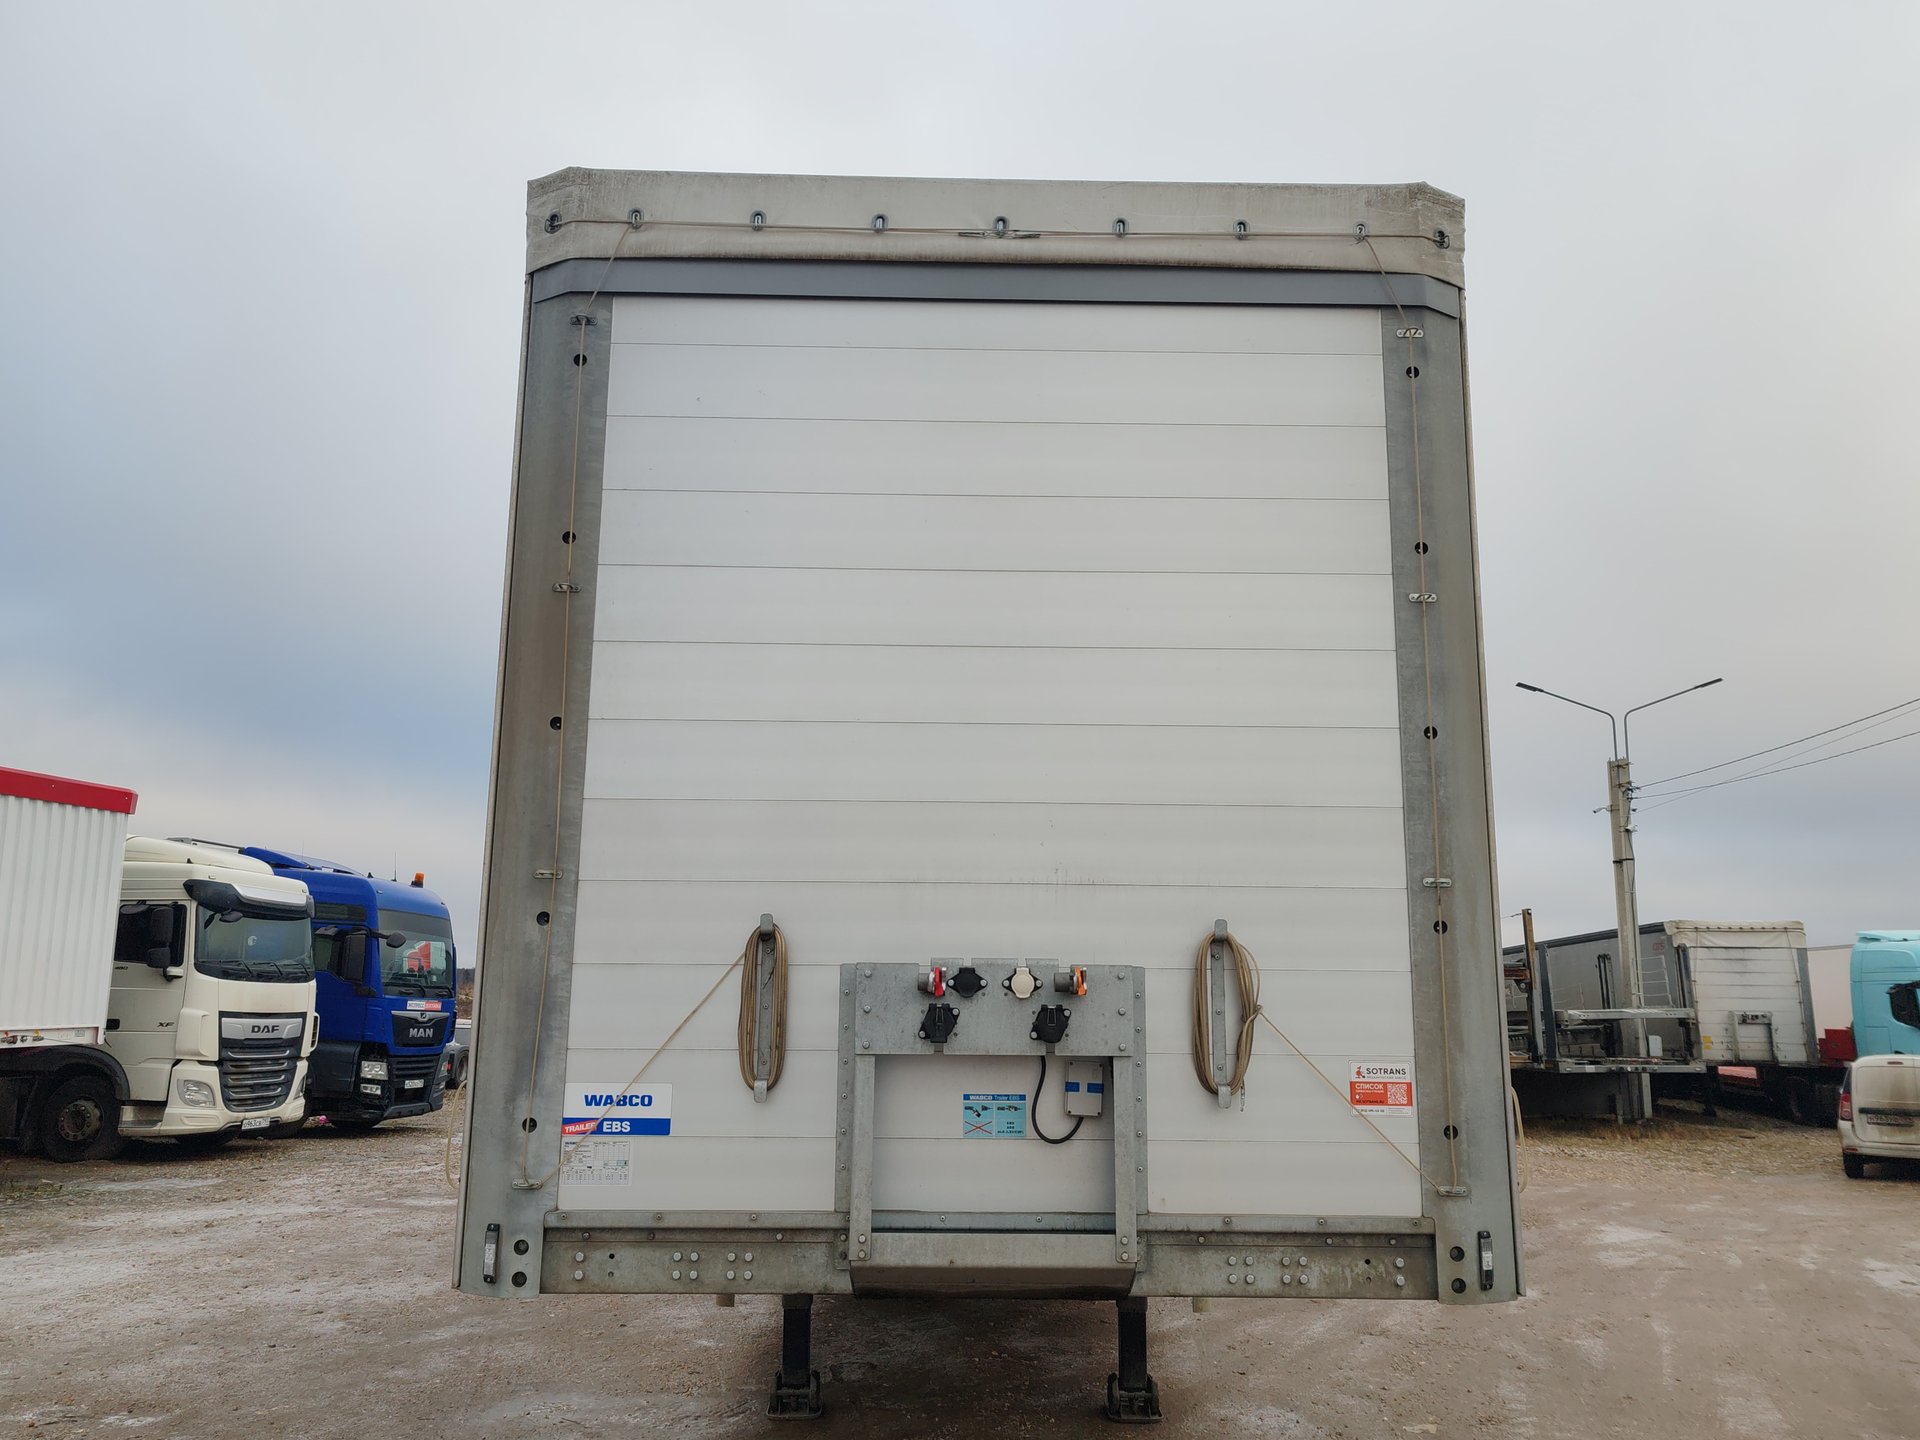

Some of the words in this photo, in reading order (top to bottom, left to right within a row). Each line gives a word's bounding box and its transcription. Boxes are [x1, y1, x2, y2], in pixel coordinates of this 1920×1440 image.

[250, 1025, 280, 1034] DAF
[409, 1028, 433, 1038] MAN
[1366, 1067, 1407, 1076] SOTRANS
[584, 1094, 653, 1107] WABCO
[602, 1120, 631, 1133] EBS
